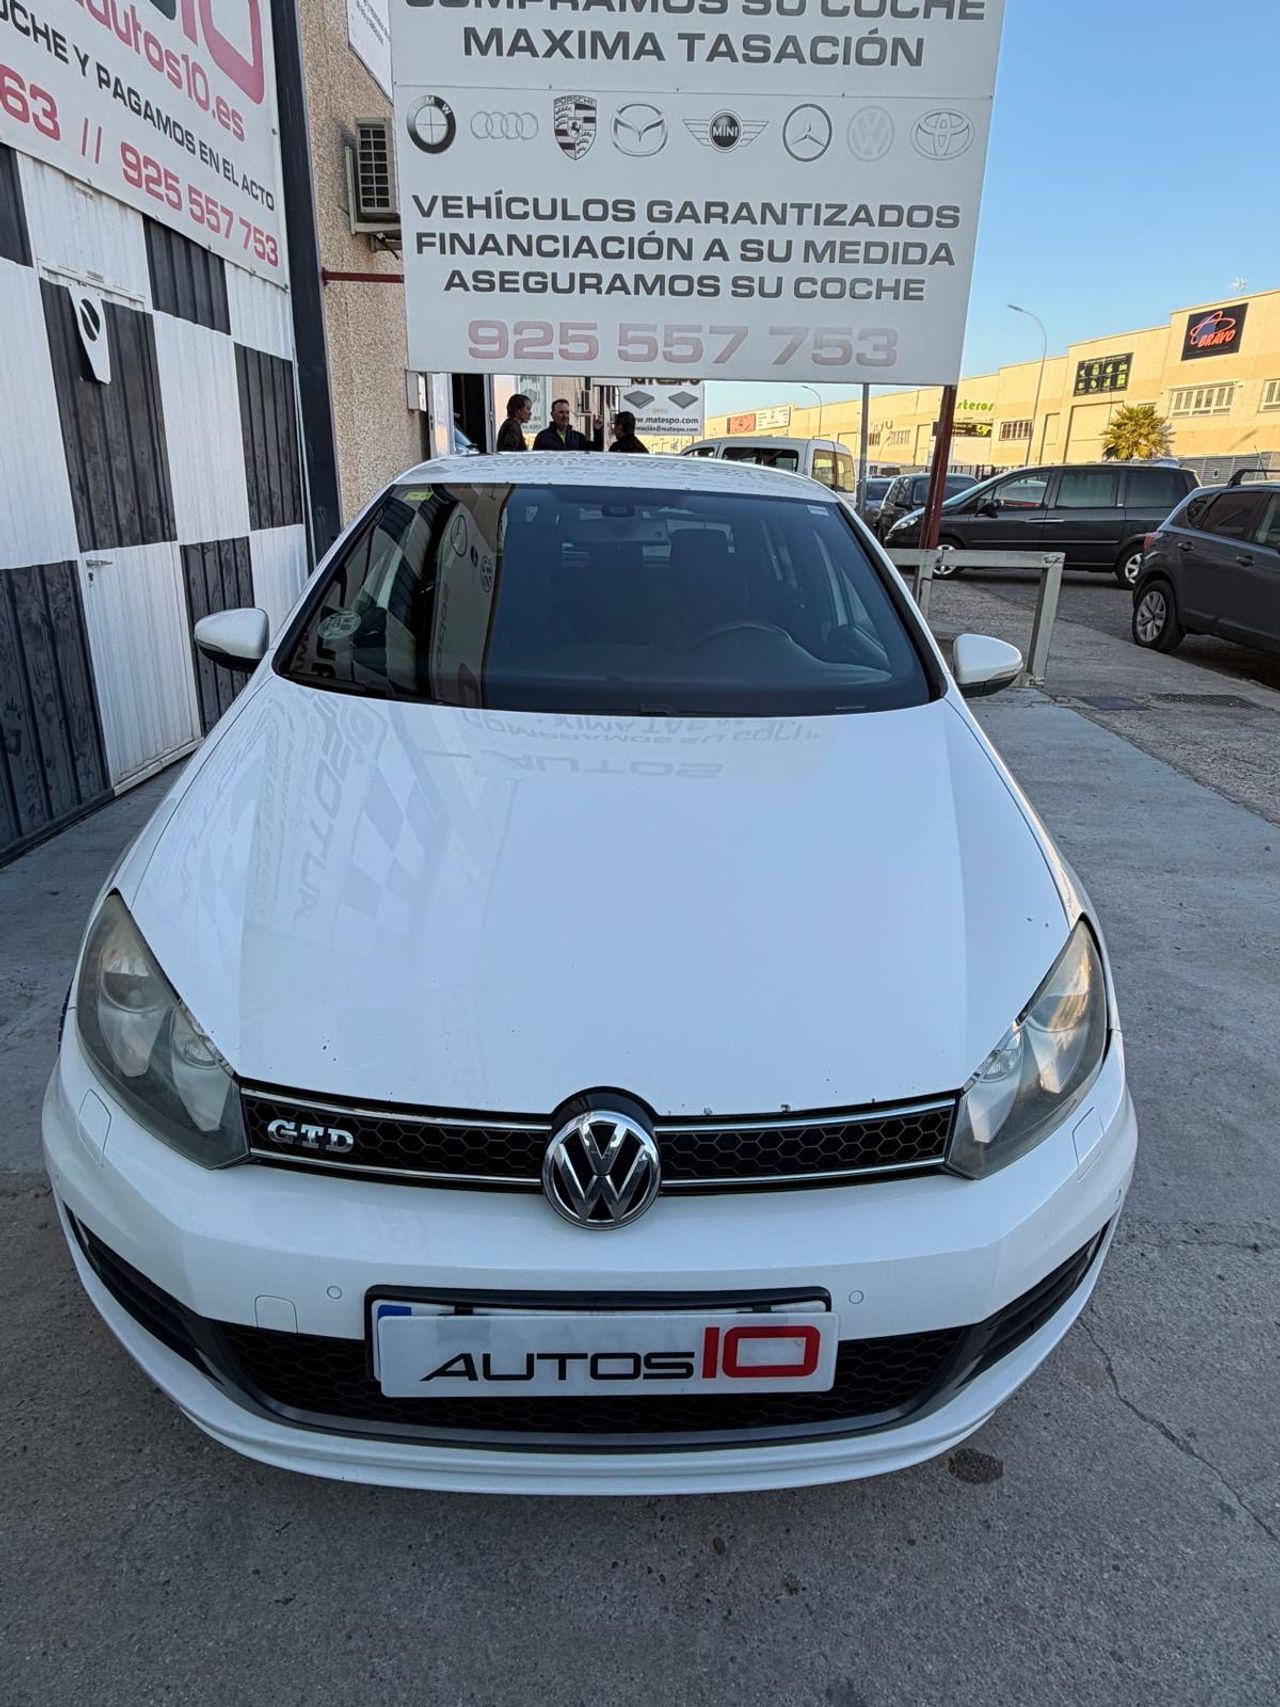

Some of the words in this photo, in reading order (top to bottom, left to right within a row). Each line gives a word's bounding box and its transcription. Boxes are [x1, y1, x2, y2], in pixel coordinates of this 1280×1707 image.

[821, 0, 985, 20] COCHE
[463, 27, 666, 61] MAXIMA
[677, 27, 925, 67] TASACIÓN
[72, 44, 90, 77] Y
[96, 61, 196, 156] PAGAMOS
[199, 140, 221, 174] EN
[222, 157, 240, 190] EL
[242, 174, 274, 211] ACTO
[712, 125, 738, 137] MINI
[120, 141, 182, 211] 925
[188, 184, 234, 240] 557
[239, 216, 279, 267] 753
[412, 189, 636, 222] VEHÍCULOS
[646, 200, 961, 228] GARANTIZADOS
[416, 230, 694, 261] FINANCIACIÓN
[703, 238, 730, 262] A
[740, 239, 793, 263] SU
[803, 240, 956, 266] MEDIDA
[444, 270, 721, 297] ASEGURAMOS
[731, 276, 783, 298] SU
[794, 277, 926, 301] COCHE
[468, 319, 600, 361] 925
[617, 323, 749, 365] 557
[769, 326, 898, 367] 753
[1198, 329, 1236, 347] BRAVO
[268, 1119, 355, 1153] GTD
[420, 1326, 821, 1382] AUTOS10
